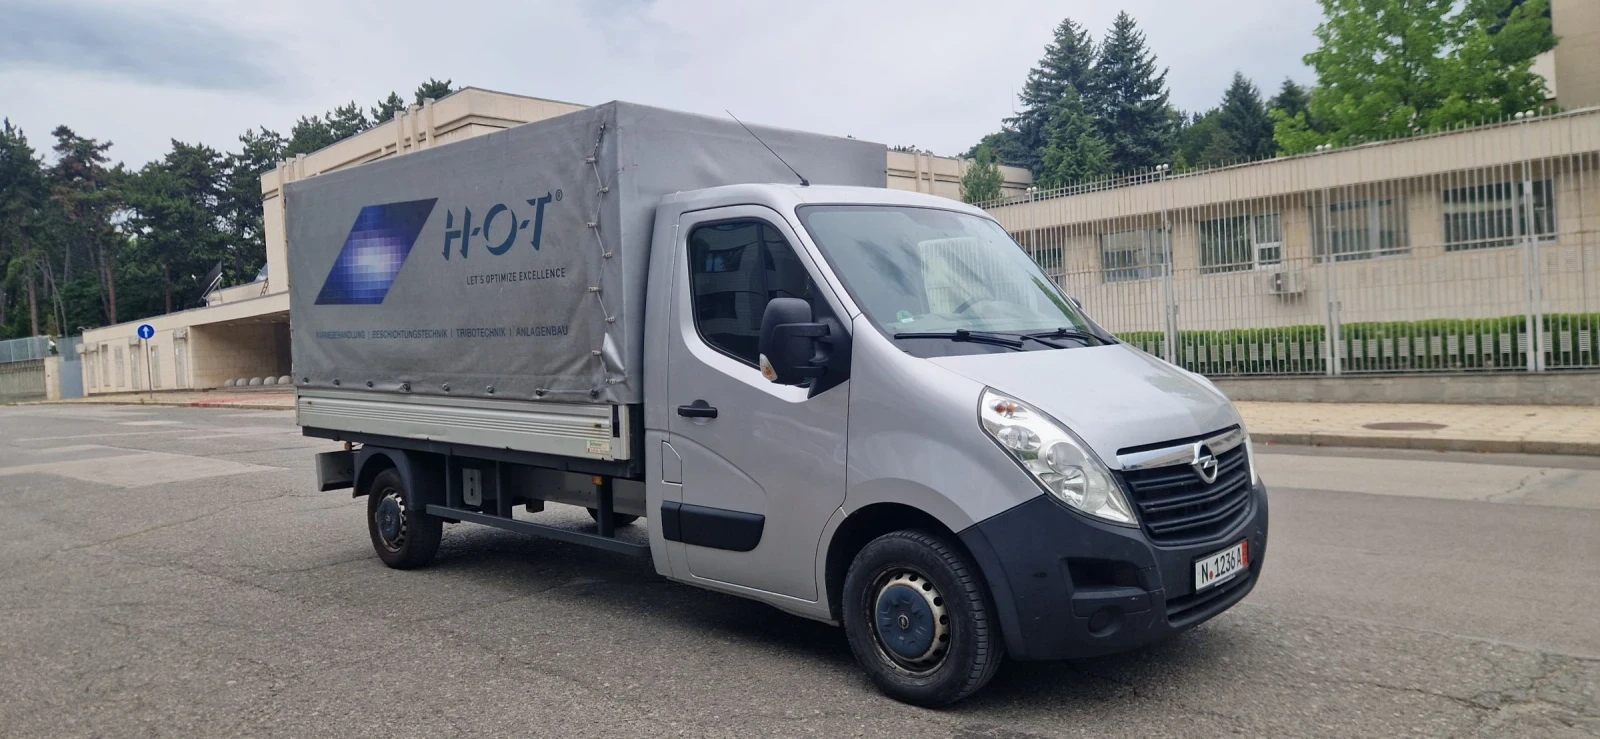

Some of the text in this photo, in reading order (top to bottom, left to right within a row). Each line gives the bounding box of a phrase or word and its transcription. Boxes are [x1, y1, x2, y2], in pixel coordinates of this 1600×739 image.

[485, 272, 517, 284] OPTIMIZE
[519, 267, 566, 281] EXCELLENCE
[456, 327, 506, 338] TRIBOTECHNIK
[516, 325, 569, 337] ANLAGENBAU
